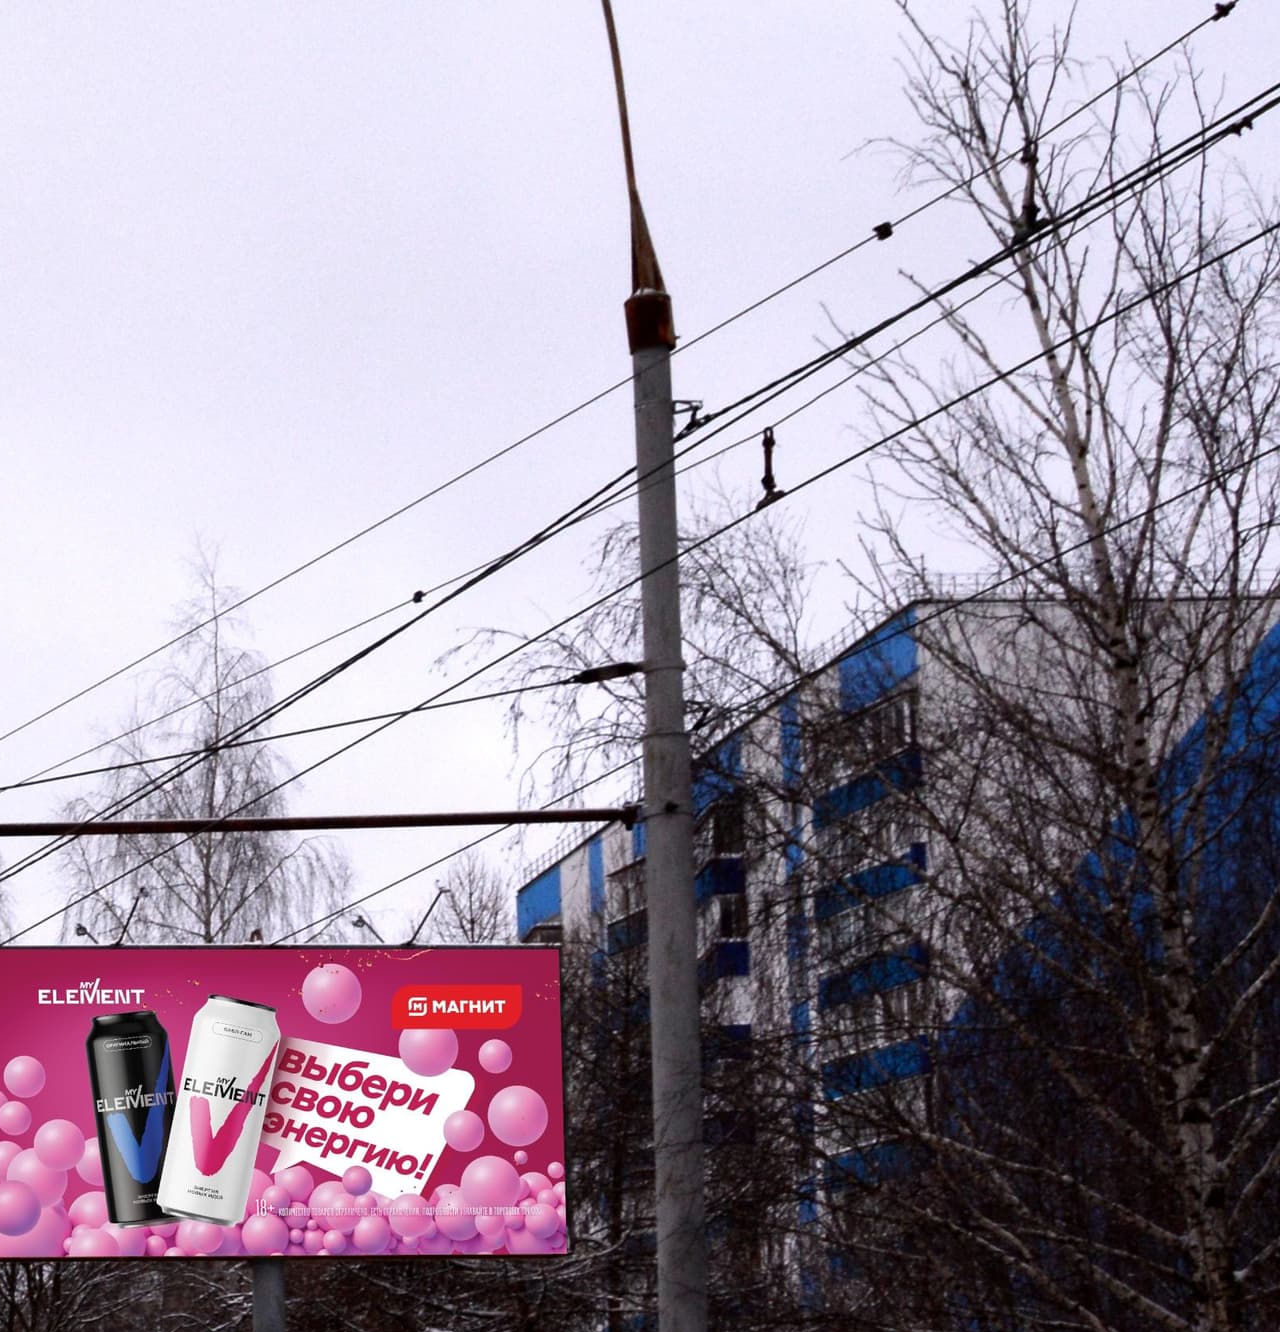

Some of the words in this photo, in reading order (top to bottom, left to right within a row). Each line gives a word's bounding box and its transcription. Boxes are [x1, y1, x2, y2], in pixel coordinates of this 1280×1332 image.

[38, 978, 145, 1005] ELEMENT
[432, 1000, 506, 1014] МАГНИТ
[96, 1084, 175, 1113] ELEMENT
[183, 1076, 266, 1107] ELEMENT
[271, 1081, 375, 1129] свою
[262, 1112, 433, 1180] энергию!
[255, 1199, 275, 1217] 18+
